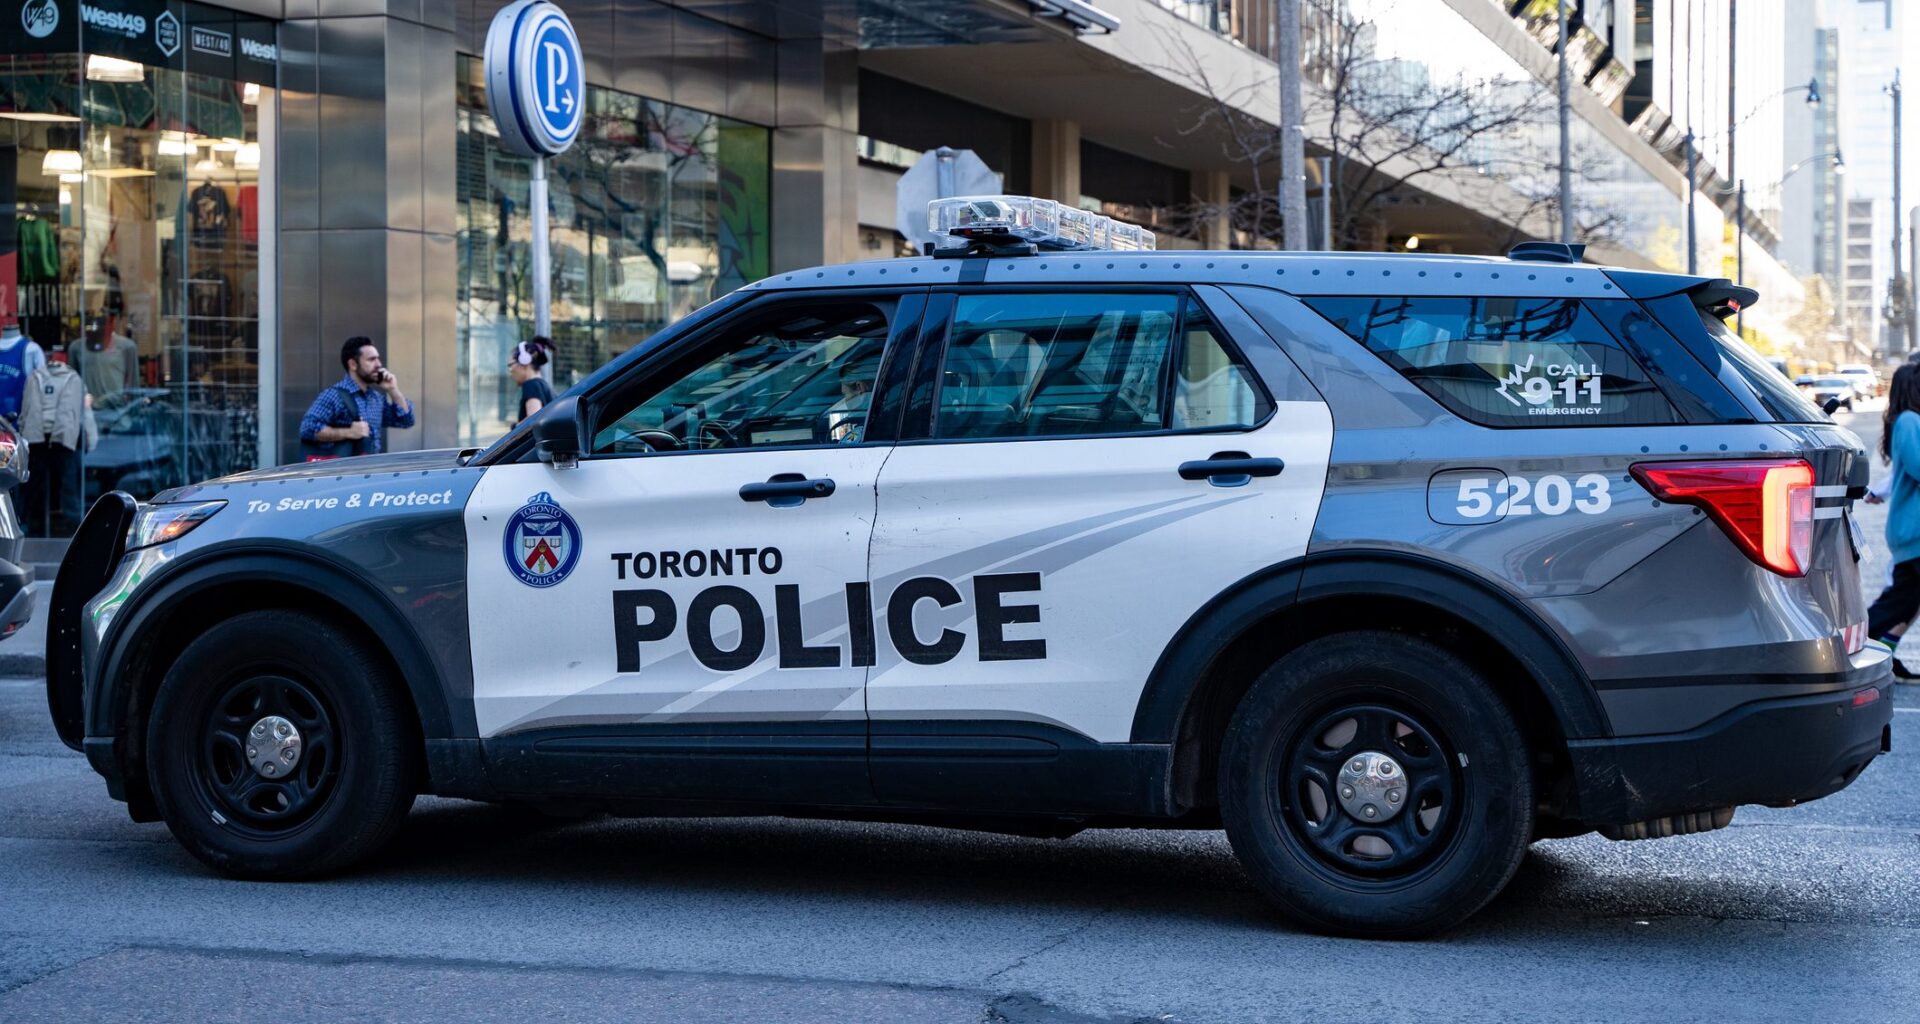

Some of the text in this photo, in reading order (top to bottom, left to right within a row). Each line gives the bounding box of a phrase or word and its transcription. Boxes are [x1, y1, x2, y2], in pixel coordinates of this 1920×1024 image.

[81, 4, 146, 34] West49
[543, 41, 569, 114] P
[1547, 364, 1603, 376] CALL
[1524, 376, 1601, 405] 9-1-1
[1528, 407, 1602, 415] EMERGENCY
[247, 489, 452, 514] To Serve & Protect
[1456, 473, 1612, 518] 5203
[519, 505, 562, 519] TORONTO
[611, 546, 783, 580] TORONTO
[525, 574, 558, 585] POLICE
[612, 571, 1048, 674] POLICE
